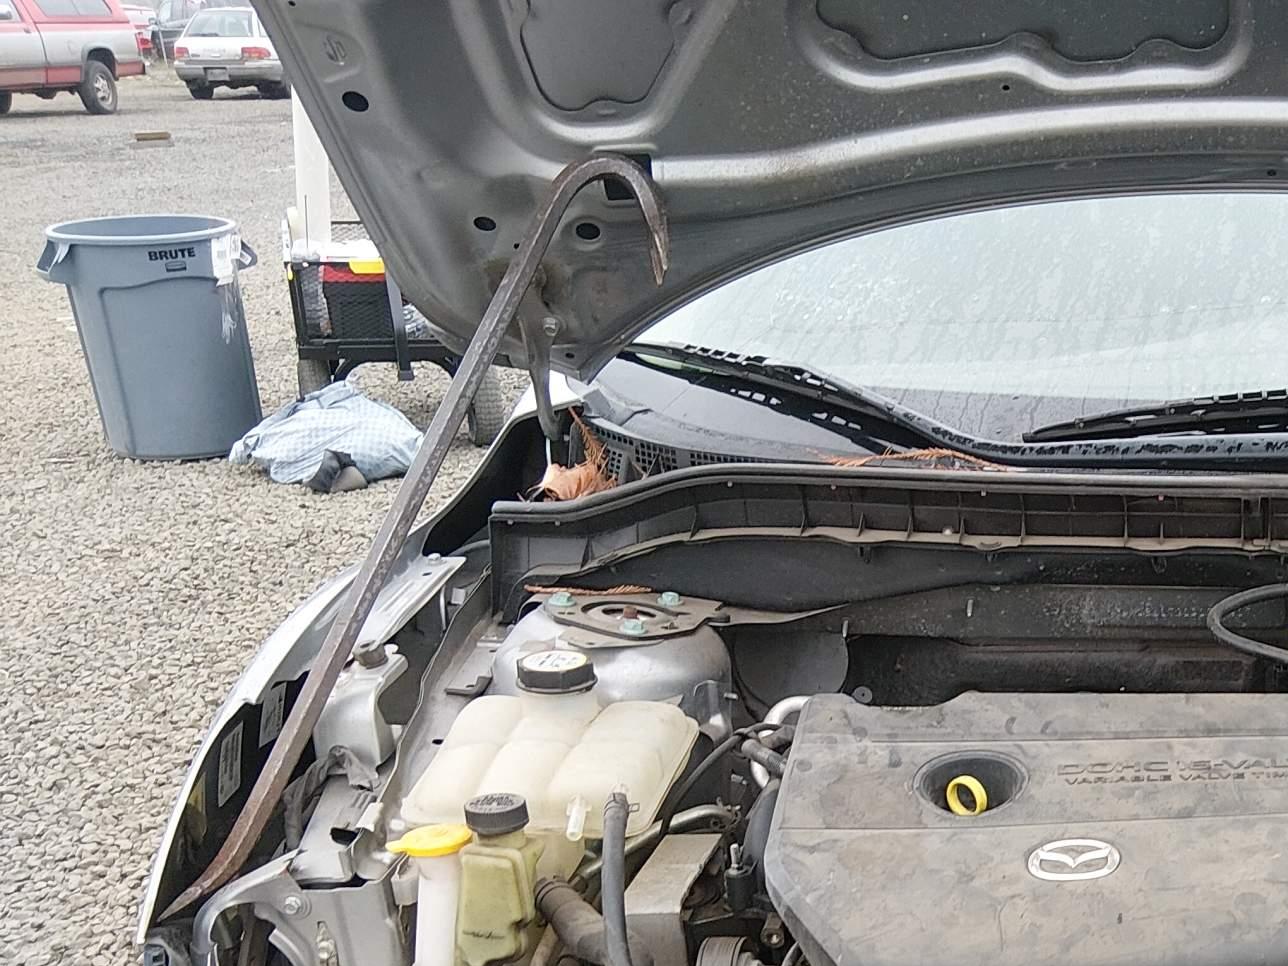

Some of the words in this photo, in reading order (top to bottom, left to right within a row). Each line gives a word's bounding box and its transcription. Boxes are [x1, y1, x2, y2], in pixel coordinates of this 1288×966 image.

[148, 247, 196, 261] BRUTE
[1058, 761, 1169, 776] DOHC
[1064, 774, 1173, 786] VARIABLE
[1179, 773, 1246, 782] VALVE
